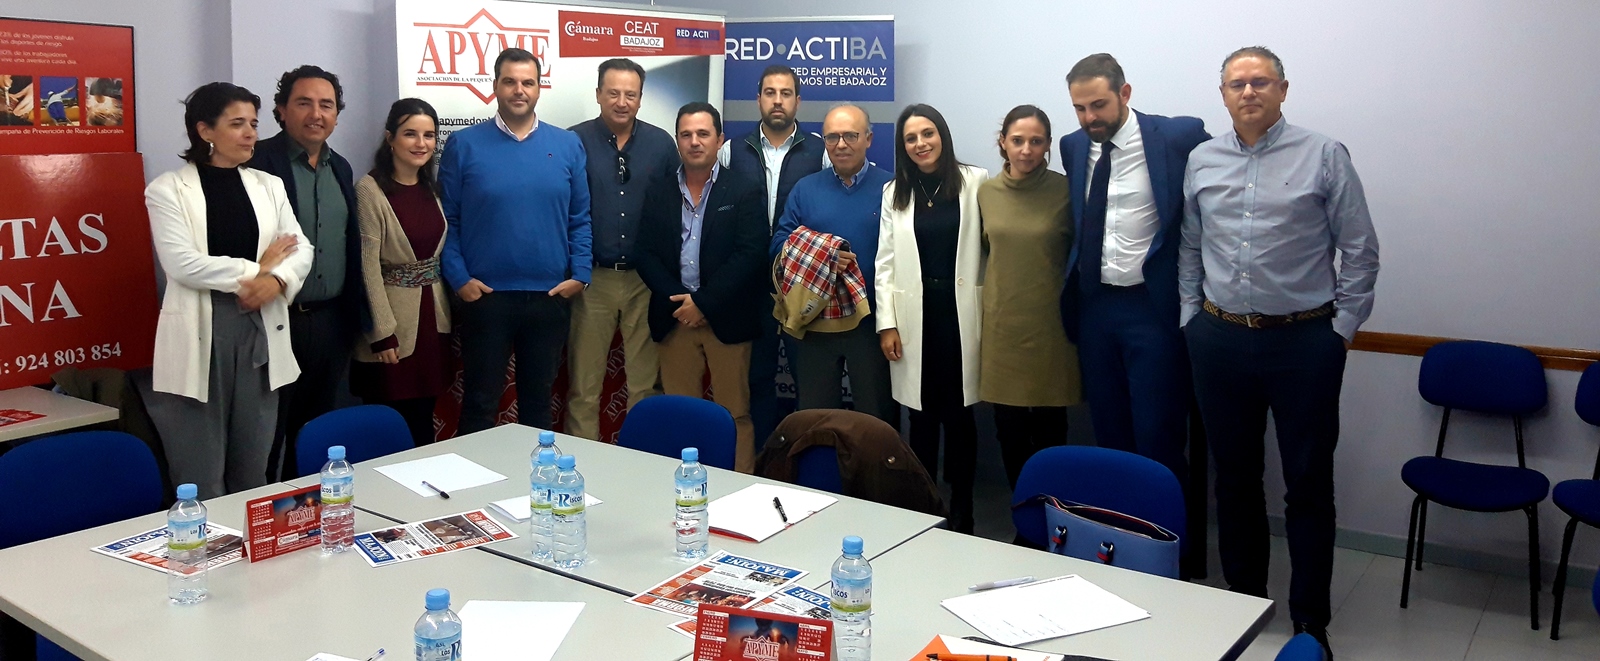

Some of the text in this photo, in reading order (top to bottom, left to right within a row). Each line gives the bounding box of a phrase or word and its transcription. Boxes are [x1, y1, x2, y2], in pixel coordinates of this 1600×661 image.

[624, 20, 660, 35] CEAT
[677, 28, 690, 38] RED
[623, 37, 661, 46] BADAJOZ
[811, 67, 878, 76] EMPRESARIAL
[880, 67, 887, 76] Y
[825, 77, 838, 86] DE
[840, 77, 887, 87] BADAJOZ
[0, 212, 108, 261] TAS
[15, 352, 49, 373] 924
[54, 347, 86, 367] 803
[91, 341, 122, 361] 854
[744, 639, 780, 659] APYME
